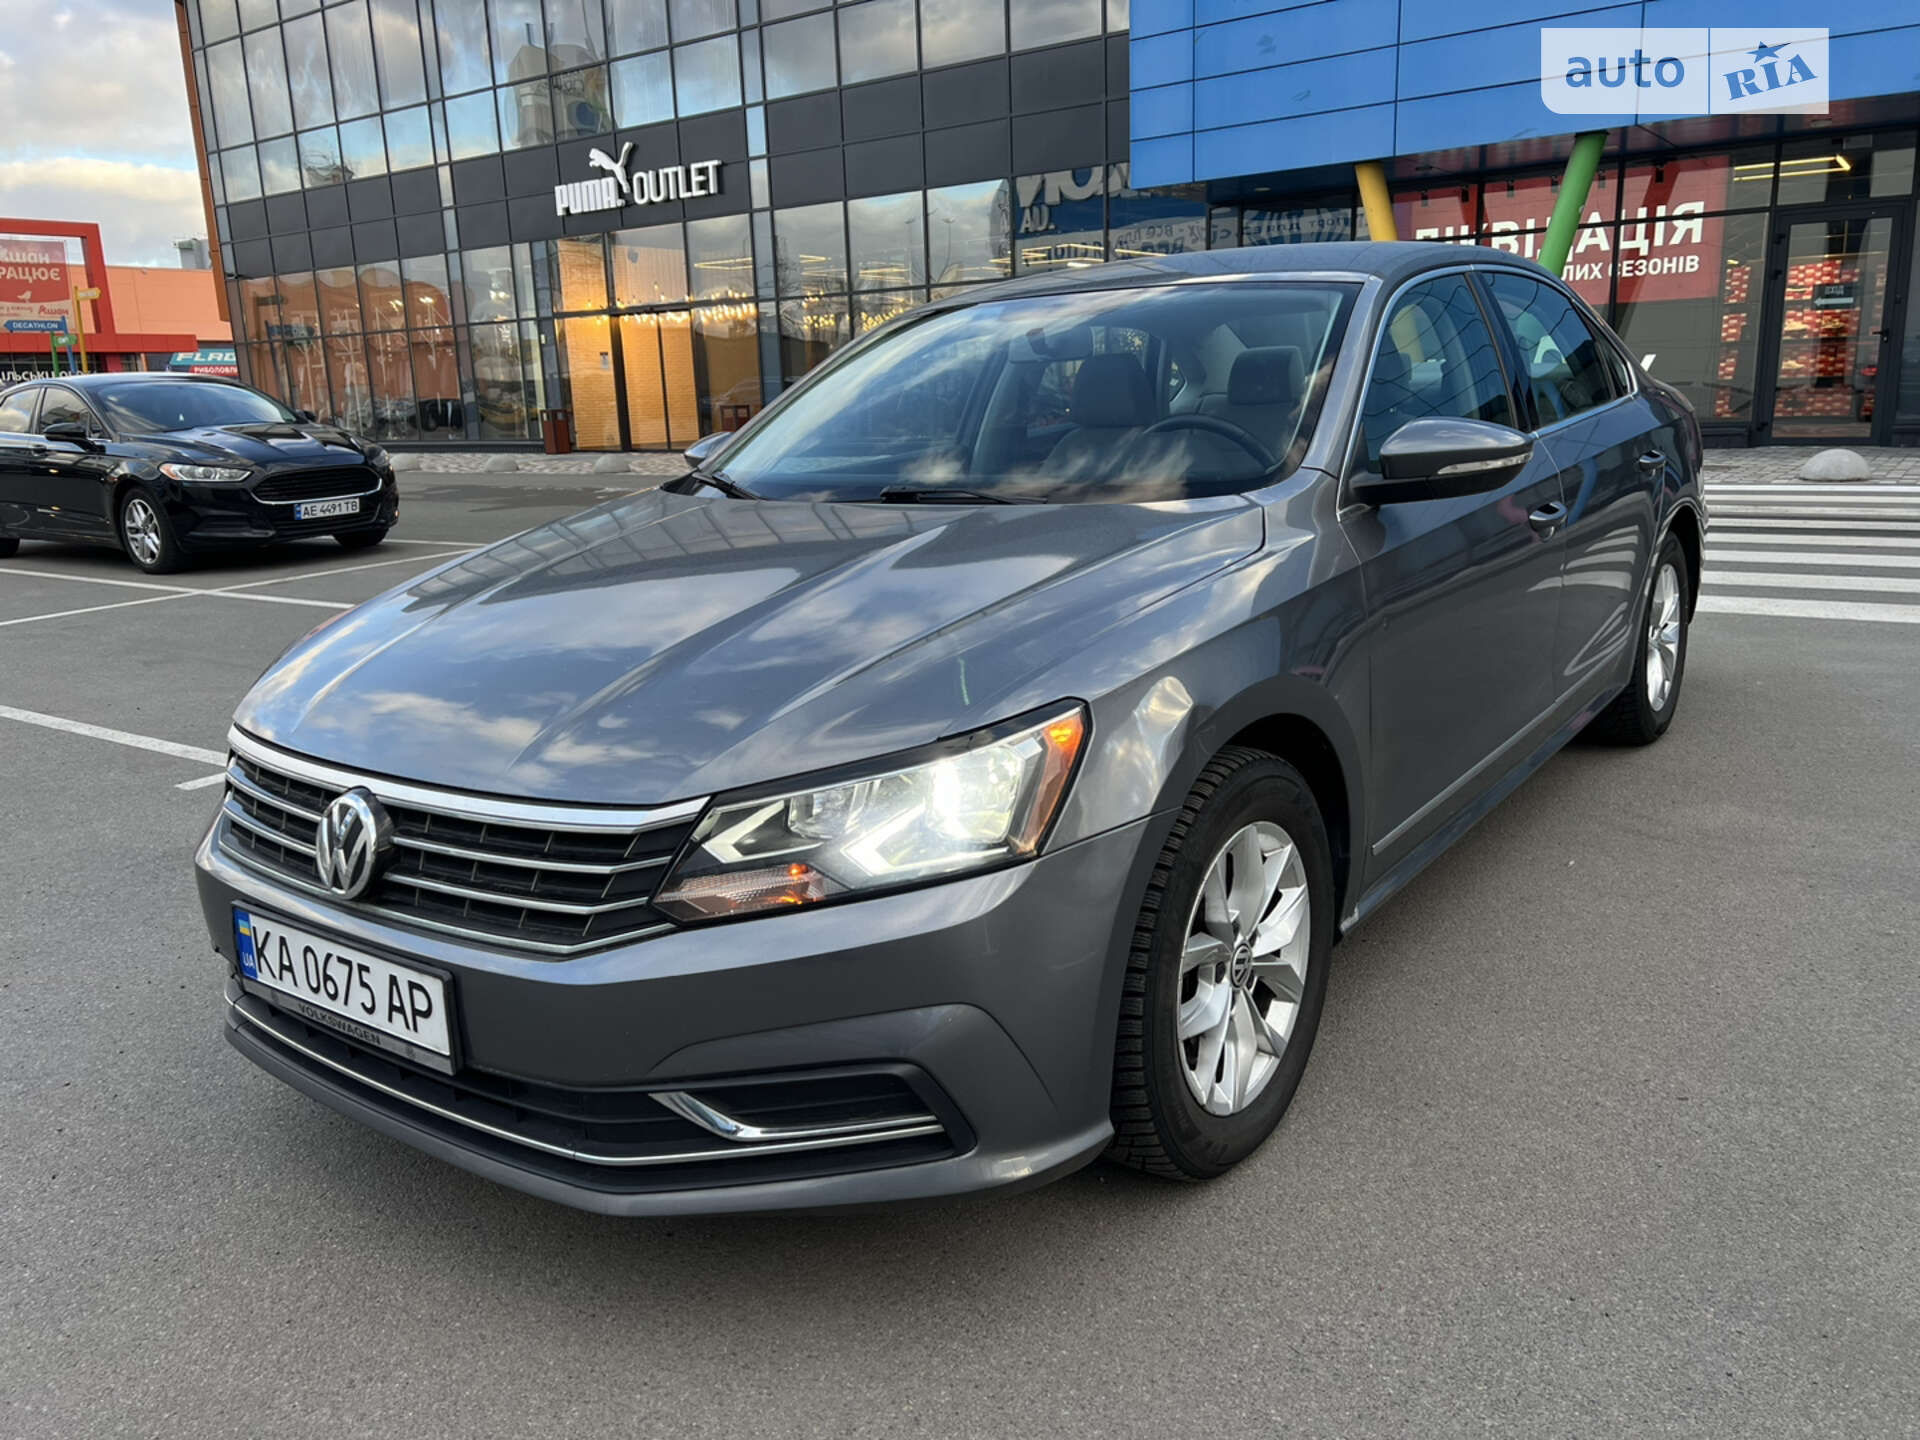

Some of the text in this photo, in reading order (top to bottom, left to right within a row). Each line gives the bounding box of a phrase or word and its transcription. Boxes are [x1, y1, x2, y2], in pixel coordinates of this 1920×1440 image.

[632, 159, 722, 205] OUTLET
[1416, 201, 1704, 262] ВІАЦІЯ
[0, 266, 61, 283] РАЦЮЄ
[12, 321, 58, 329] DECATHLON
[303, 501, 358, 517] AE 4491 TB
[242, 952, 254, 968] UA
[252, 926, 433, 1033] KA 0675 AP
[298, 1003, 381, 1045] VOLKSWAGEN
